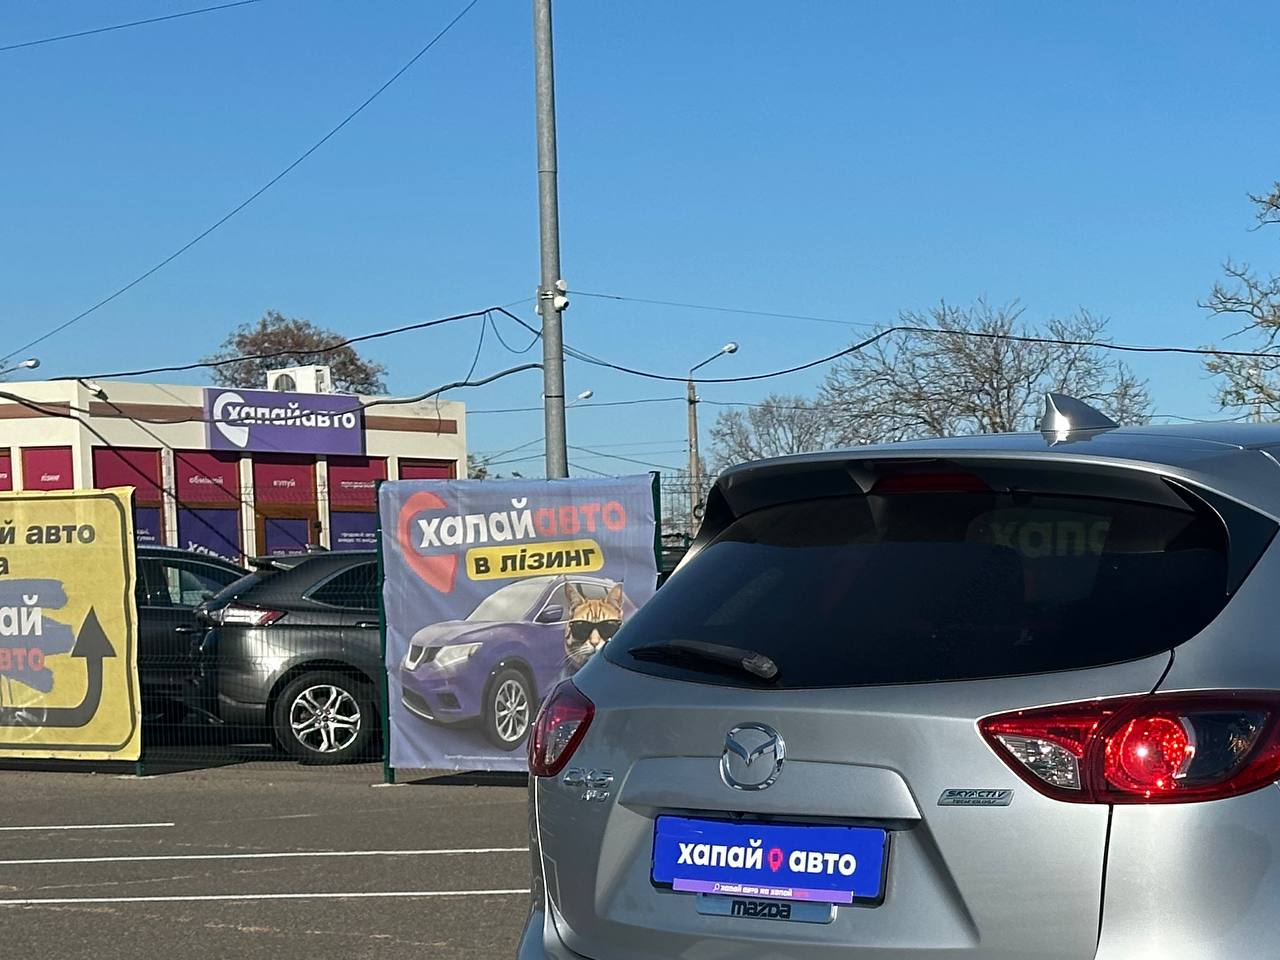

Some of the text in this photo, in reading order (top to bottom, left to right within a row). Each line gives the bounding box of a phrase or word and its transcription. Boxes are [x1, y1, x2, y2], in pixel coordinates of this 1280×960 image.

[26, 524, 96, 545] авто
[474, 548, 597, 575] в лізинг
[945, 790, 1006, 798] SKYACTIV
[677, 839, 857, 876] хапай авто
